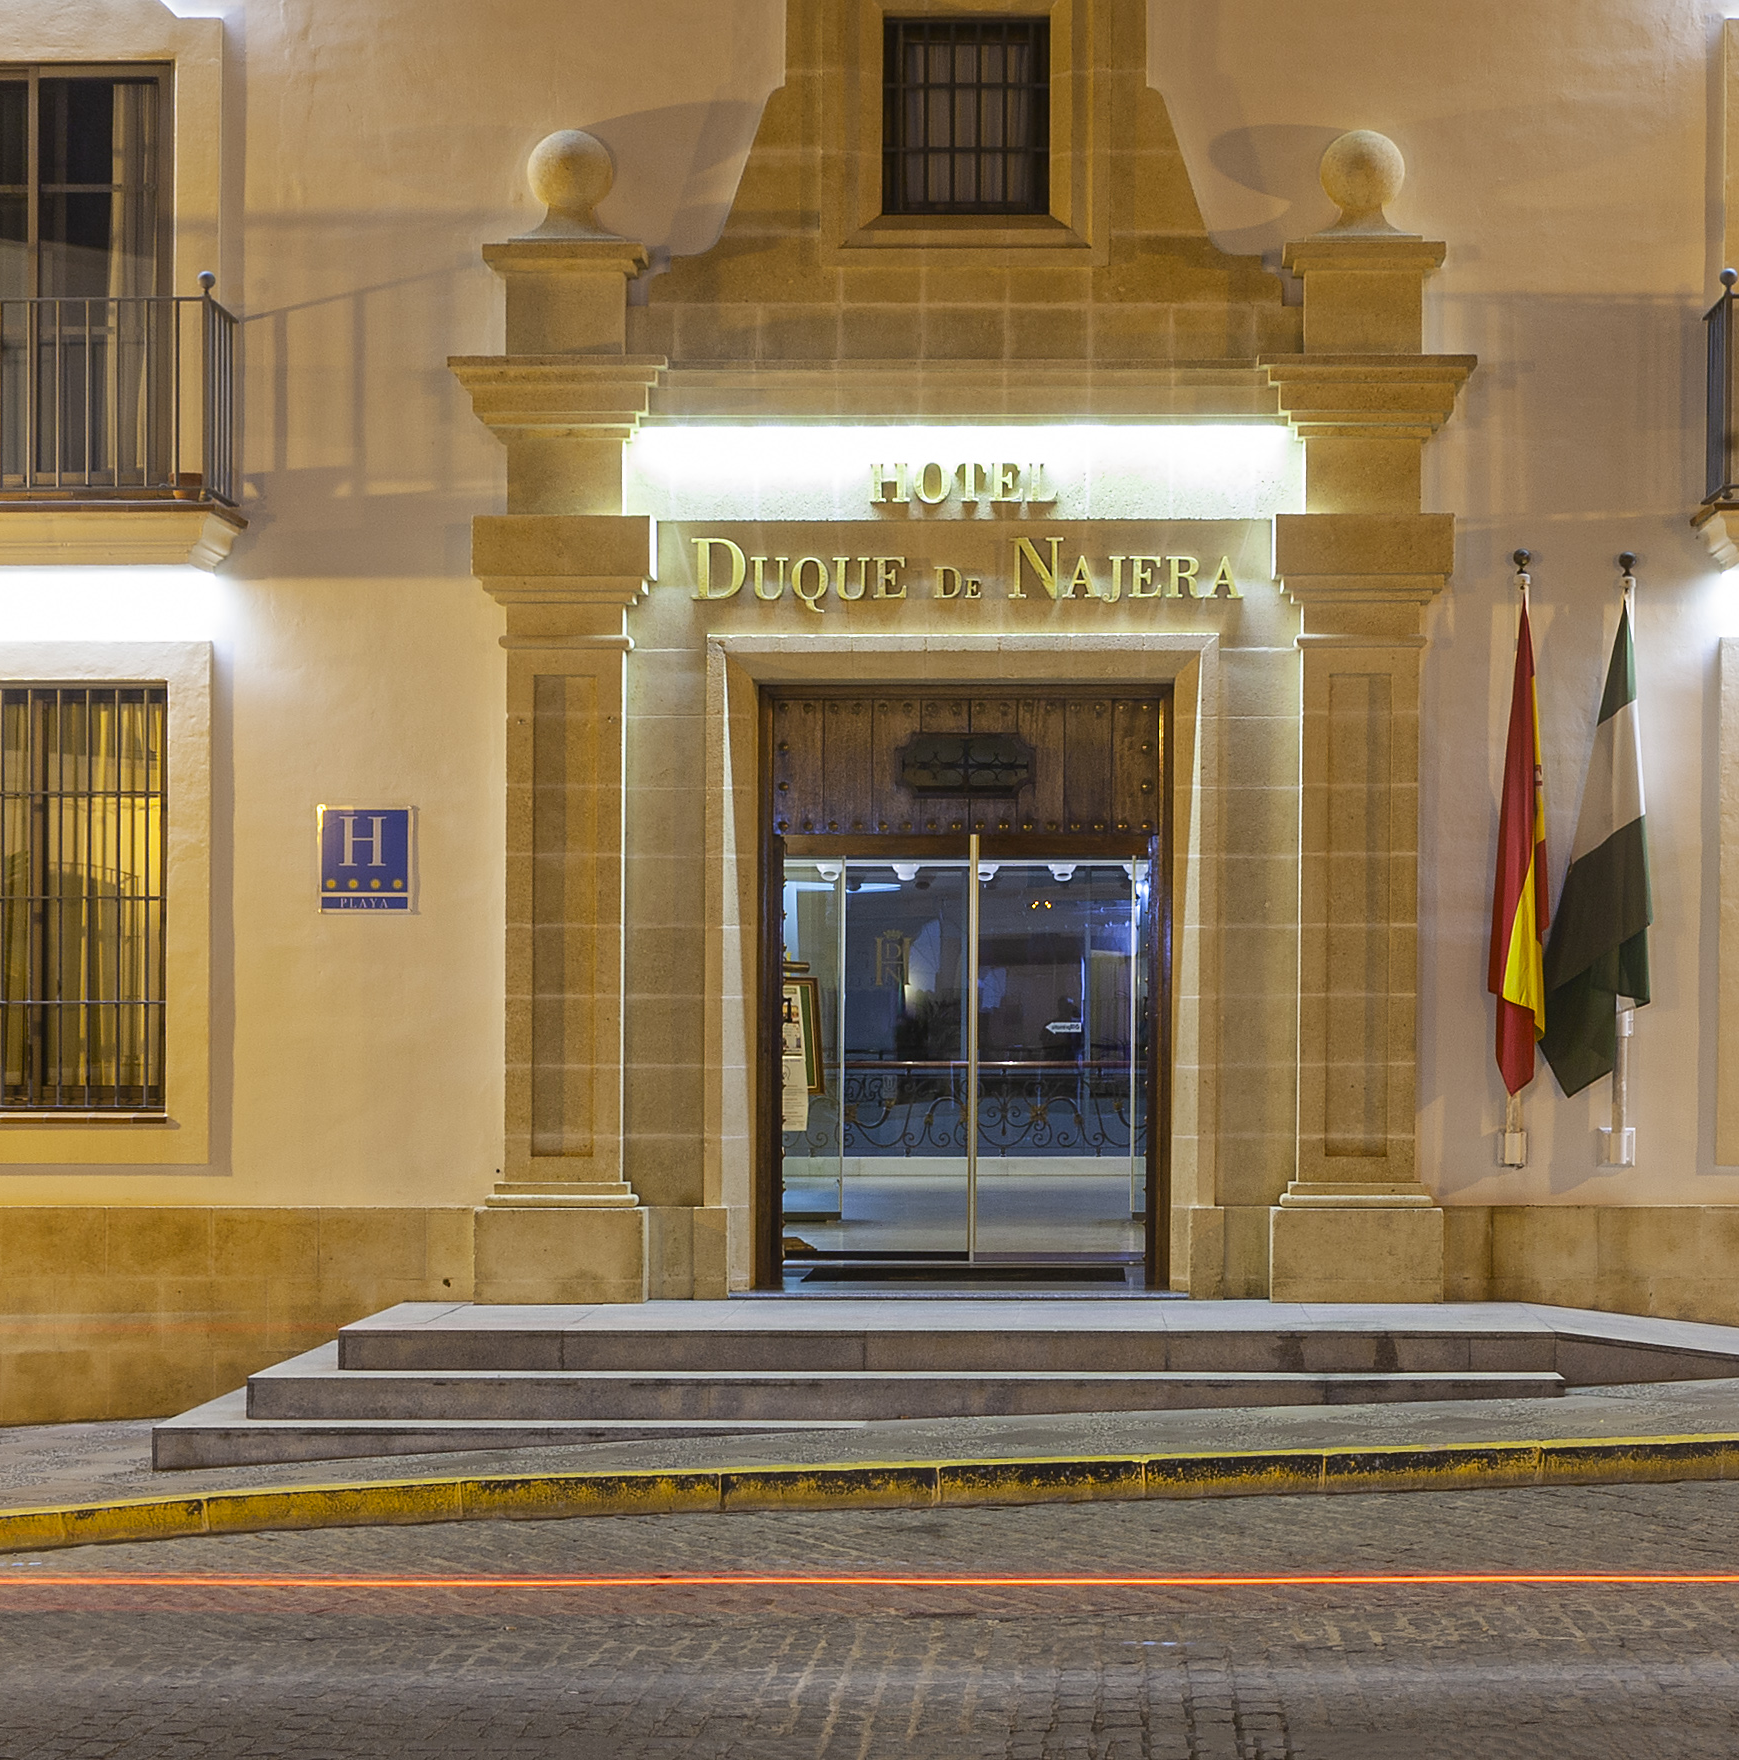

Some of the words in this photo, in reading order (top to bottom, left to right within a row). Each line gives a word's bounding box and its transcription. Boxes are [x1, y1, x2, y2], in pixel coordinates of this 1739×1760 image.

[870, 462, 1058, 504] HOTEL
[690, 537, 908, 613] DUQUE
[1007, 536, 1245, 604] NAJERA
[338, 816, 387, 866] H
[340, 897, 389, 909] PLAYA
